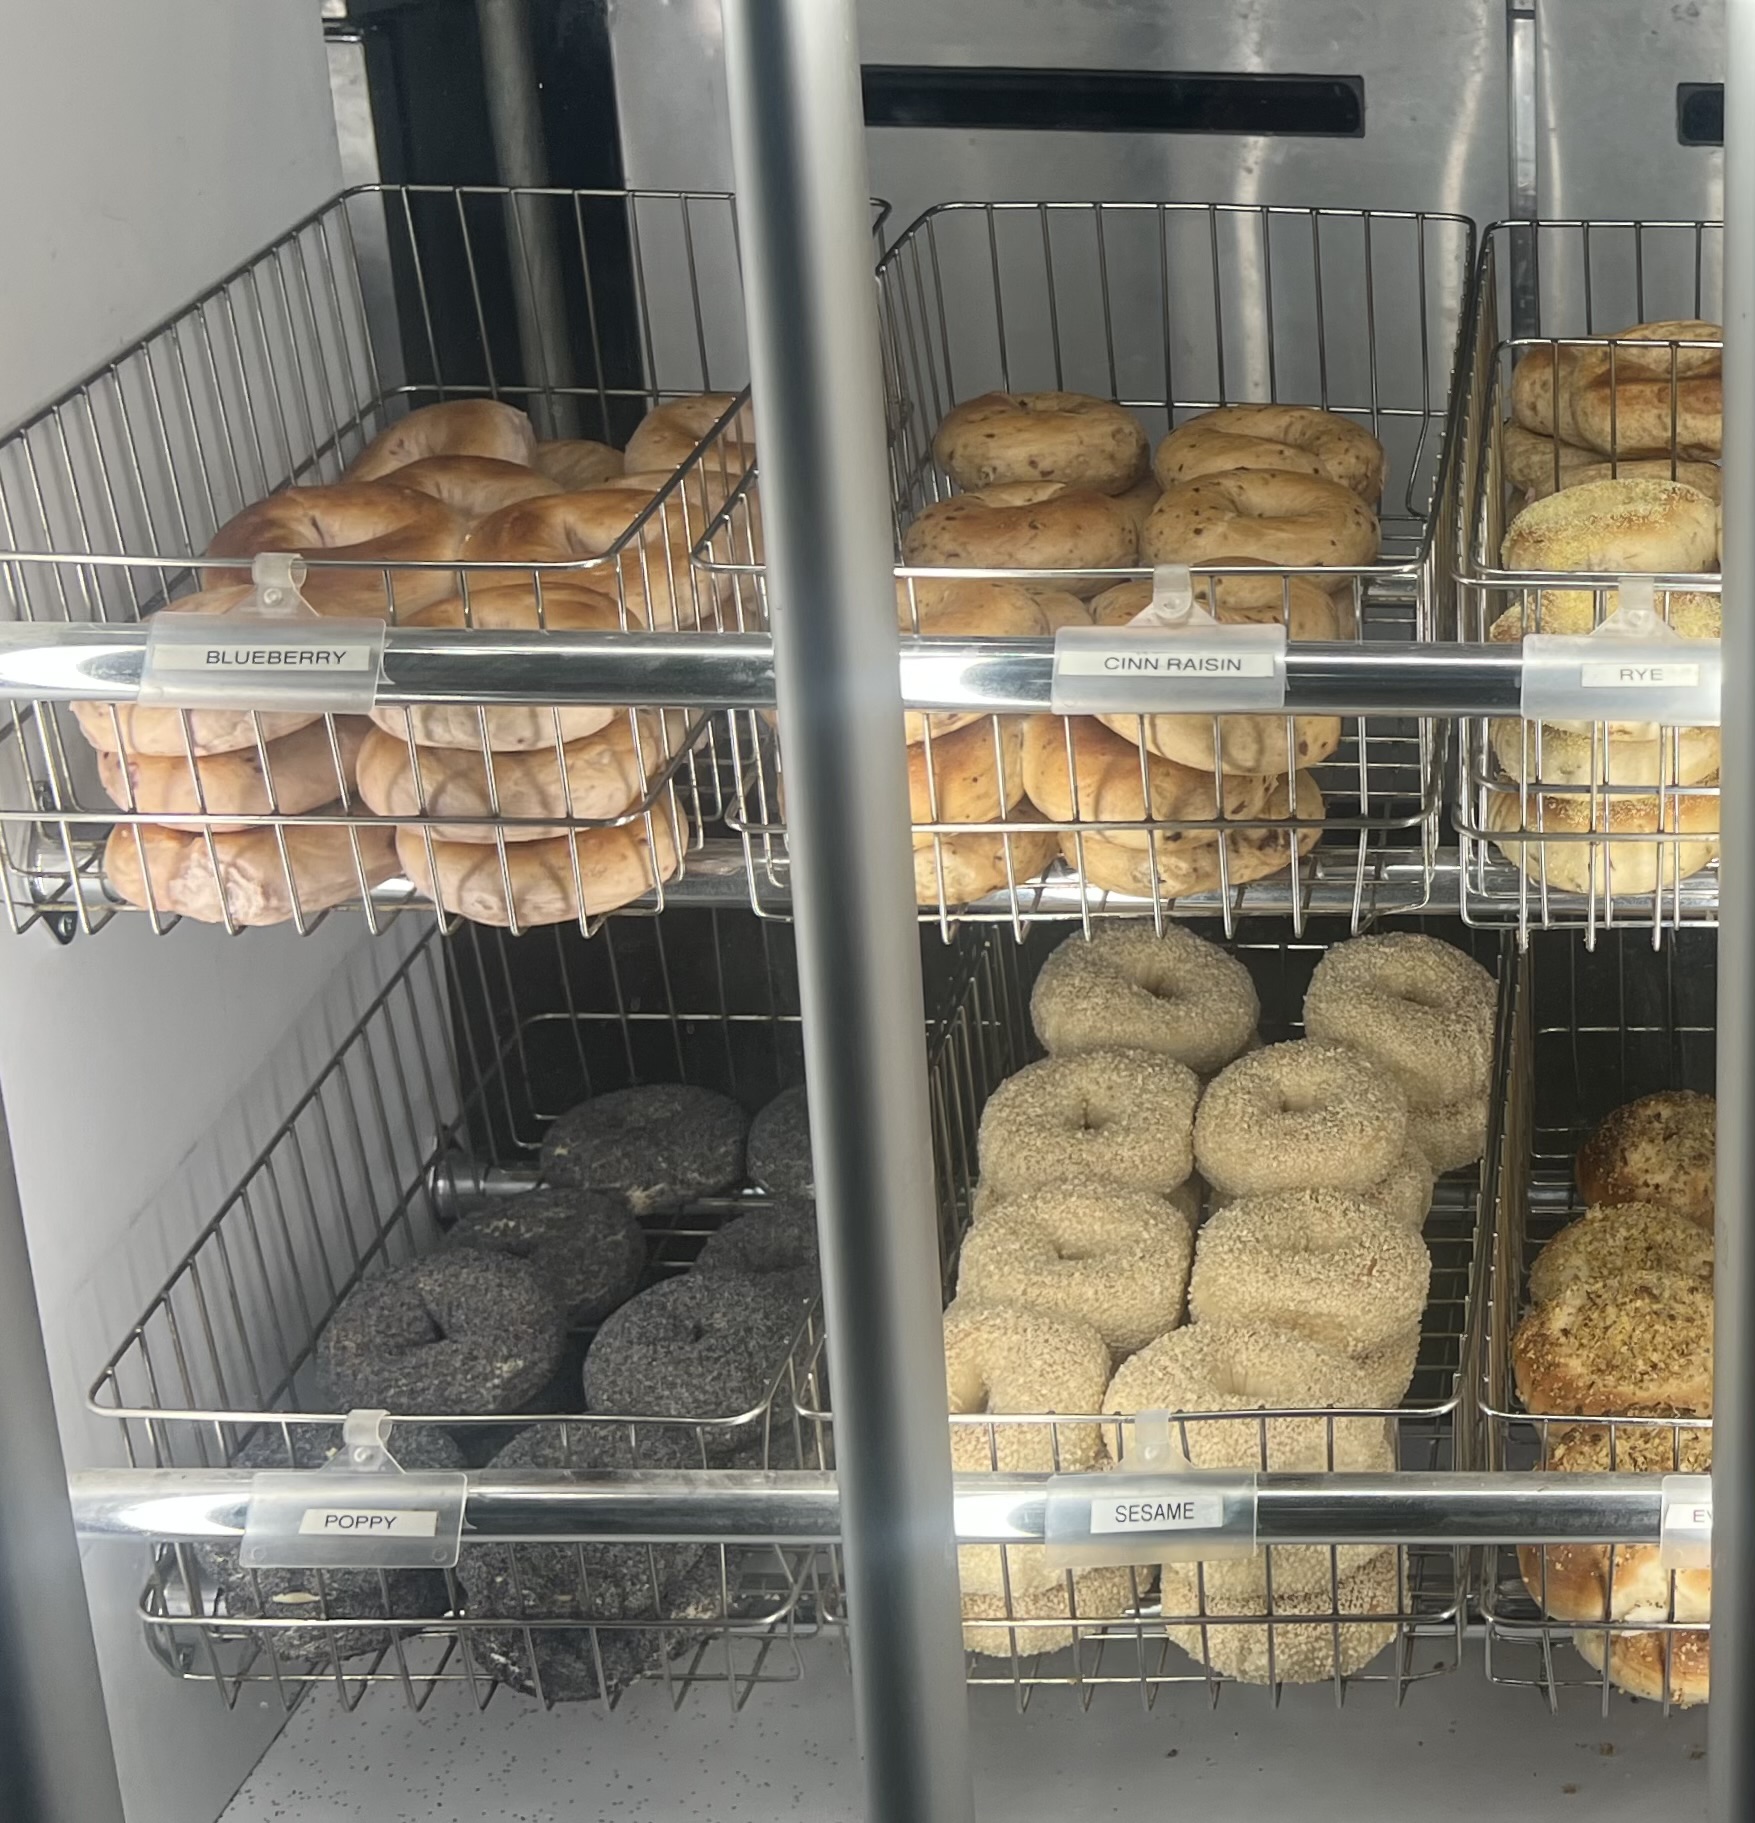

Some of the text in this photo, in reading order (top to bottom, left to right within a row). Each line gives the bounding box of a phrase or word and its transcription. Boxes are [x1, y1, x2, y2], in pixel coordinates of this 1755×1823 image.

[205, 649, 348, 667] BLUEBERRY
[1103, 656, 1242, 672] CINN RAISIN
[1619, 667, 1664, 682] RYE
[1115, 1502, 1194, 1523] SESAME
[324, 1514, 397, 1531] POPPY
